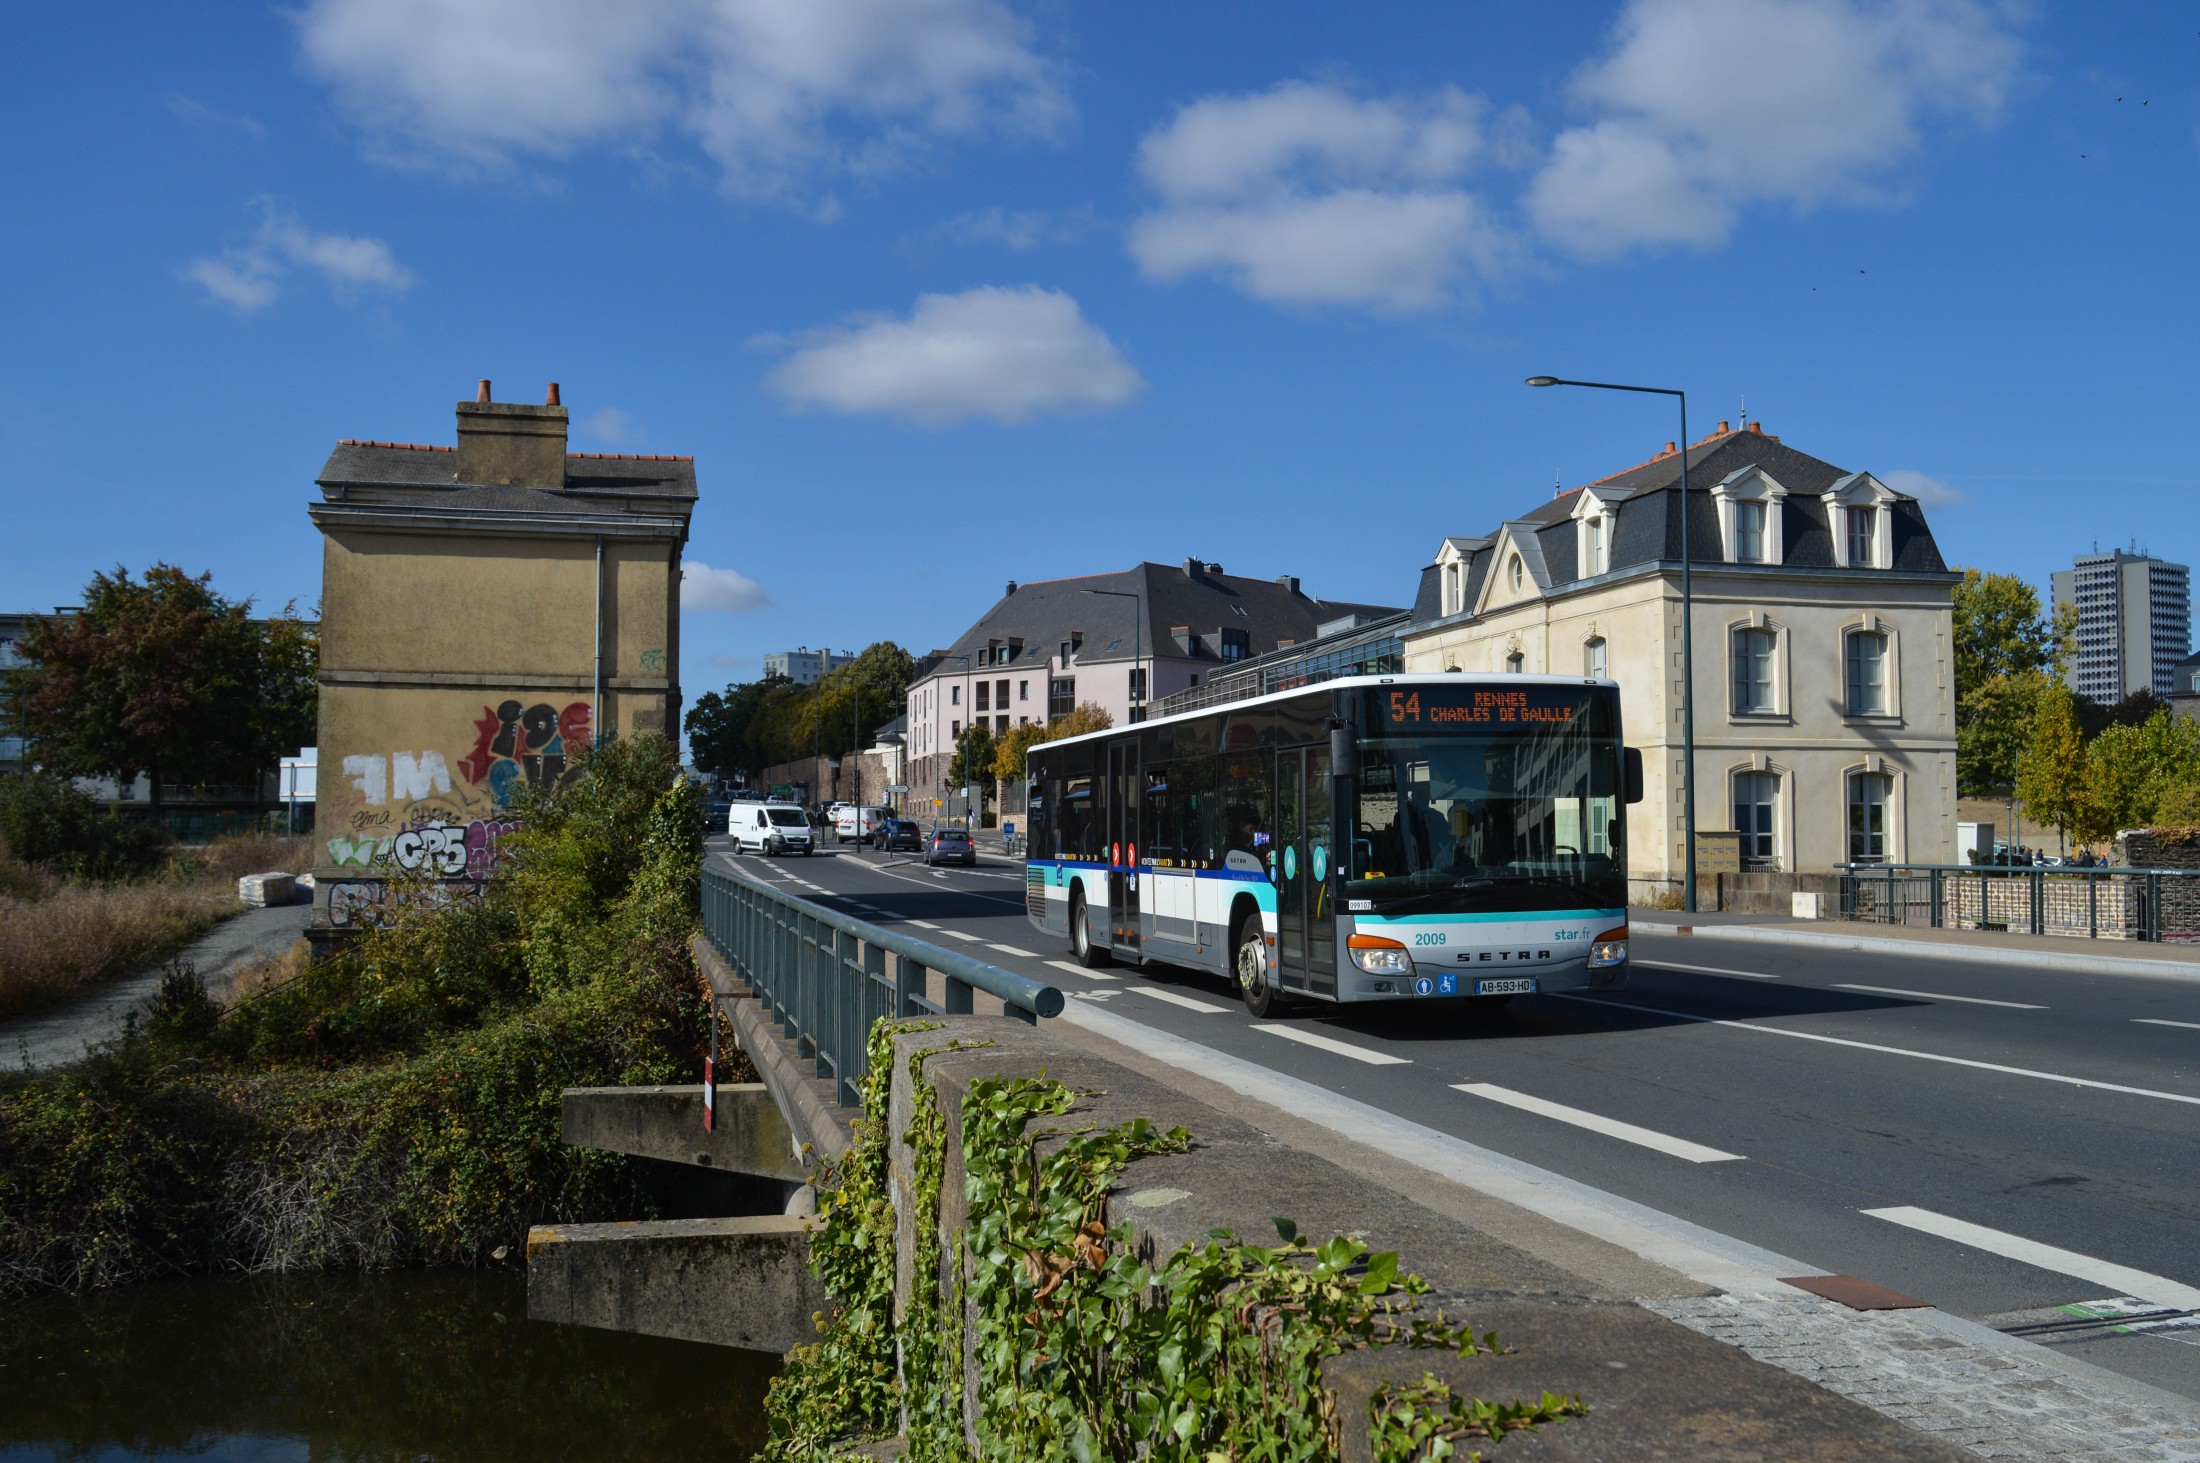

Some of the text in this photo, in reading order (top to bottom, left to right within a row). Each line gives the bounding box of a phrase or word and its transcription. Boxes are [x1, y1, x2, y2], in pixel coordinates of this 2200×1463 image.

[1390, 691, 1421, 722] 54
[1474, 692, 1527, 707] RENNES
[1430, 707, 1573, 722] CHARLES DE GAULLE
[1349, 901, 1371, 909] 099107
[1415, 933, 1446, 946] 2009
[1554, 926, 1591, 941] star.fr
[1457, 950, 1551, 962] SETRA
[1481, 980, 1530, 993] AB-593-HD
